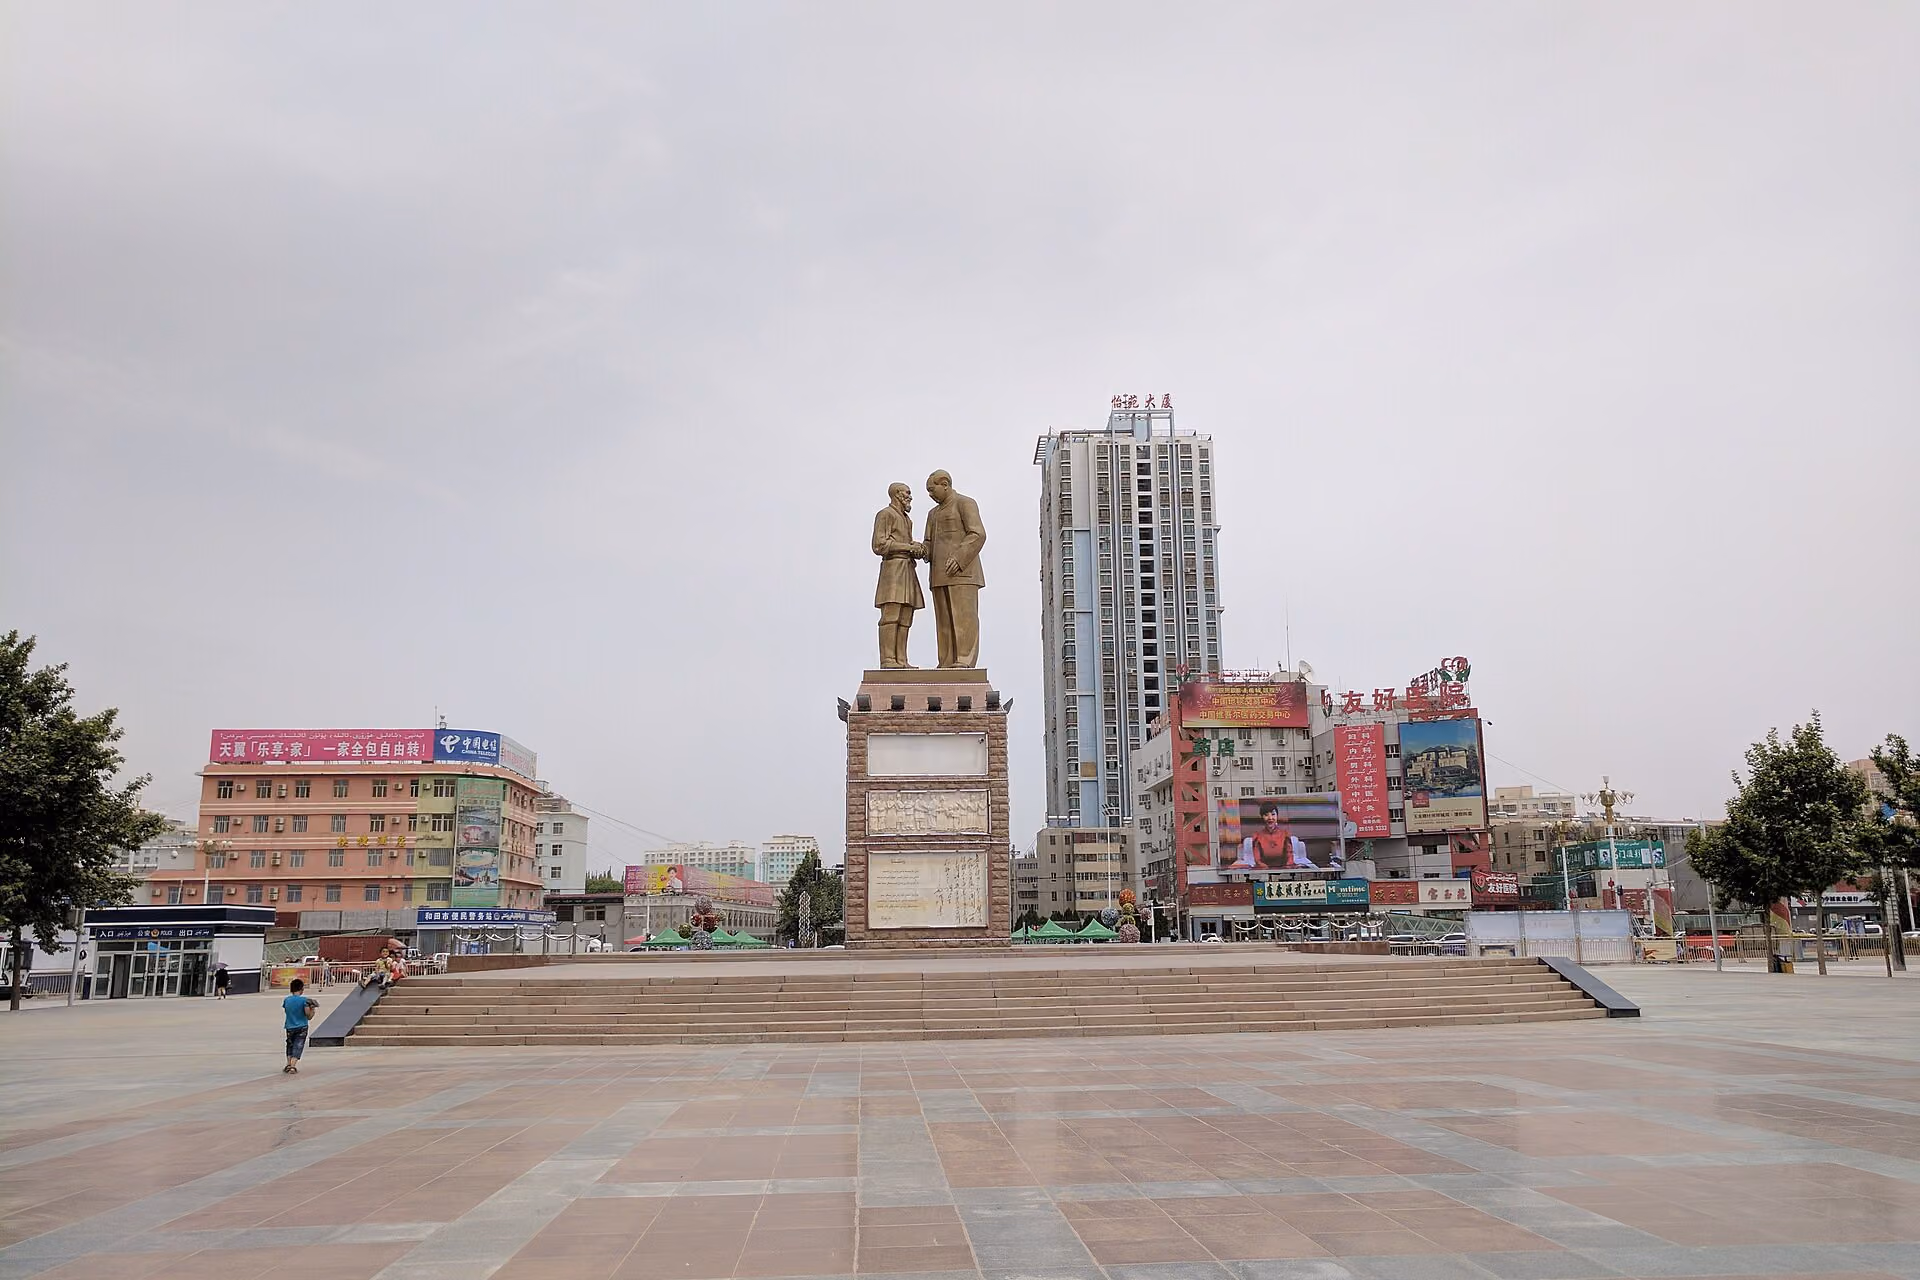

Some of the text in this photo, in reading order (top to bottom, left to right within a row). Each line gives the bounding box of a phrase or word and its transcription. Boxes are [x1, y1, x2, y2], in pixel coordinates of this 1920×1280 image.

[1111, 393, 1173, 408] 怡苑大厦
[1341, 680, 1471, 715] 友好医院
[462, 736, 497, 752] 中国电信
[1193, 737, 1235, 758] 药店
[1487, 882, 1518, 894] 友好医院
[425, 911, 493, 921] 和田市便民警务站
[178, 929, 193, 937] 出口
